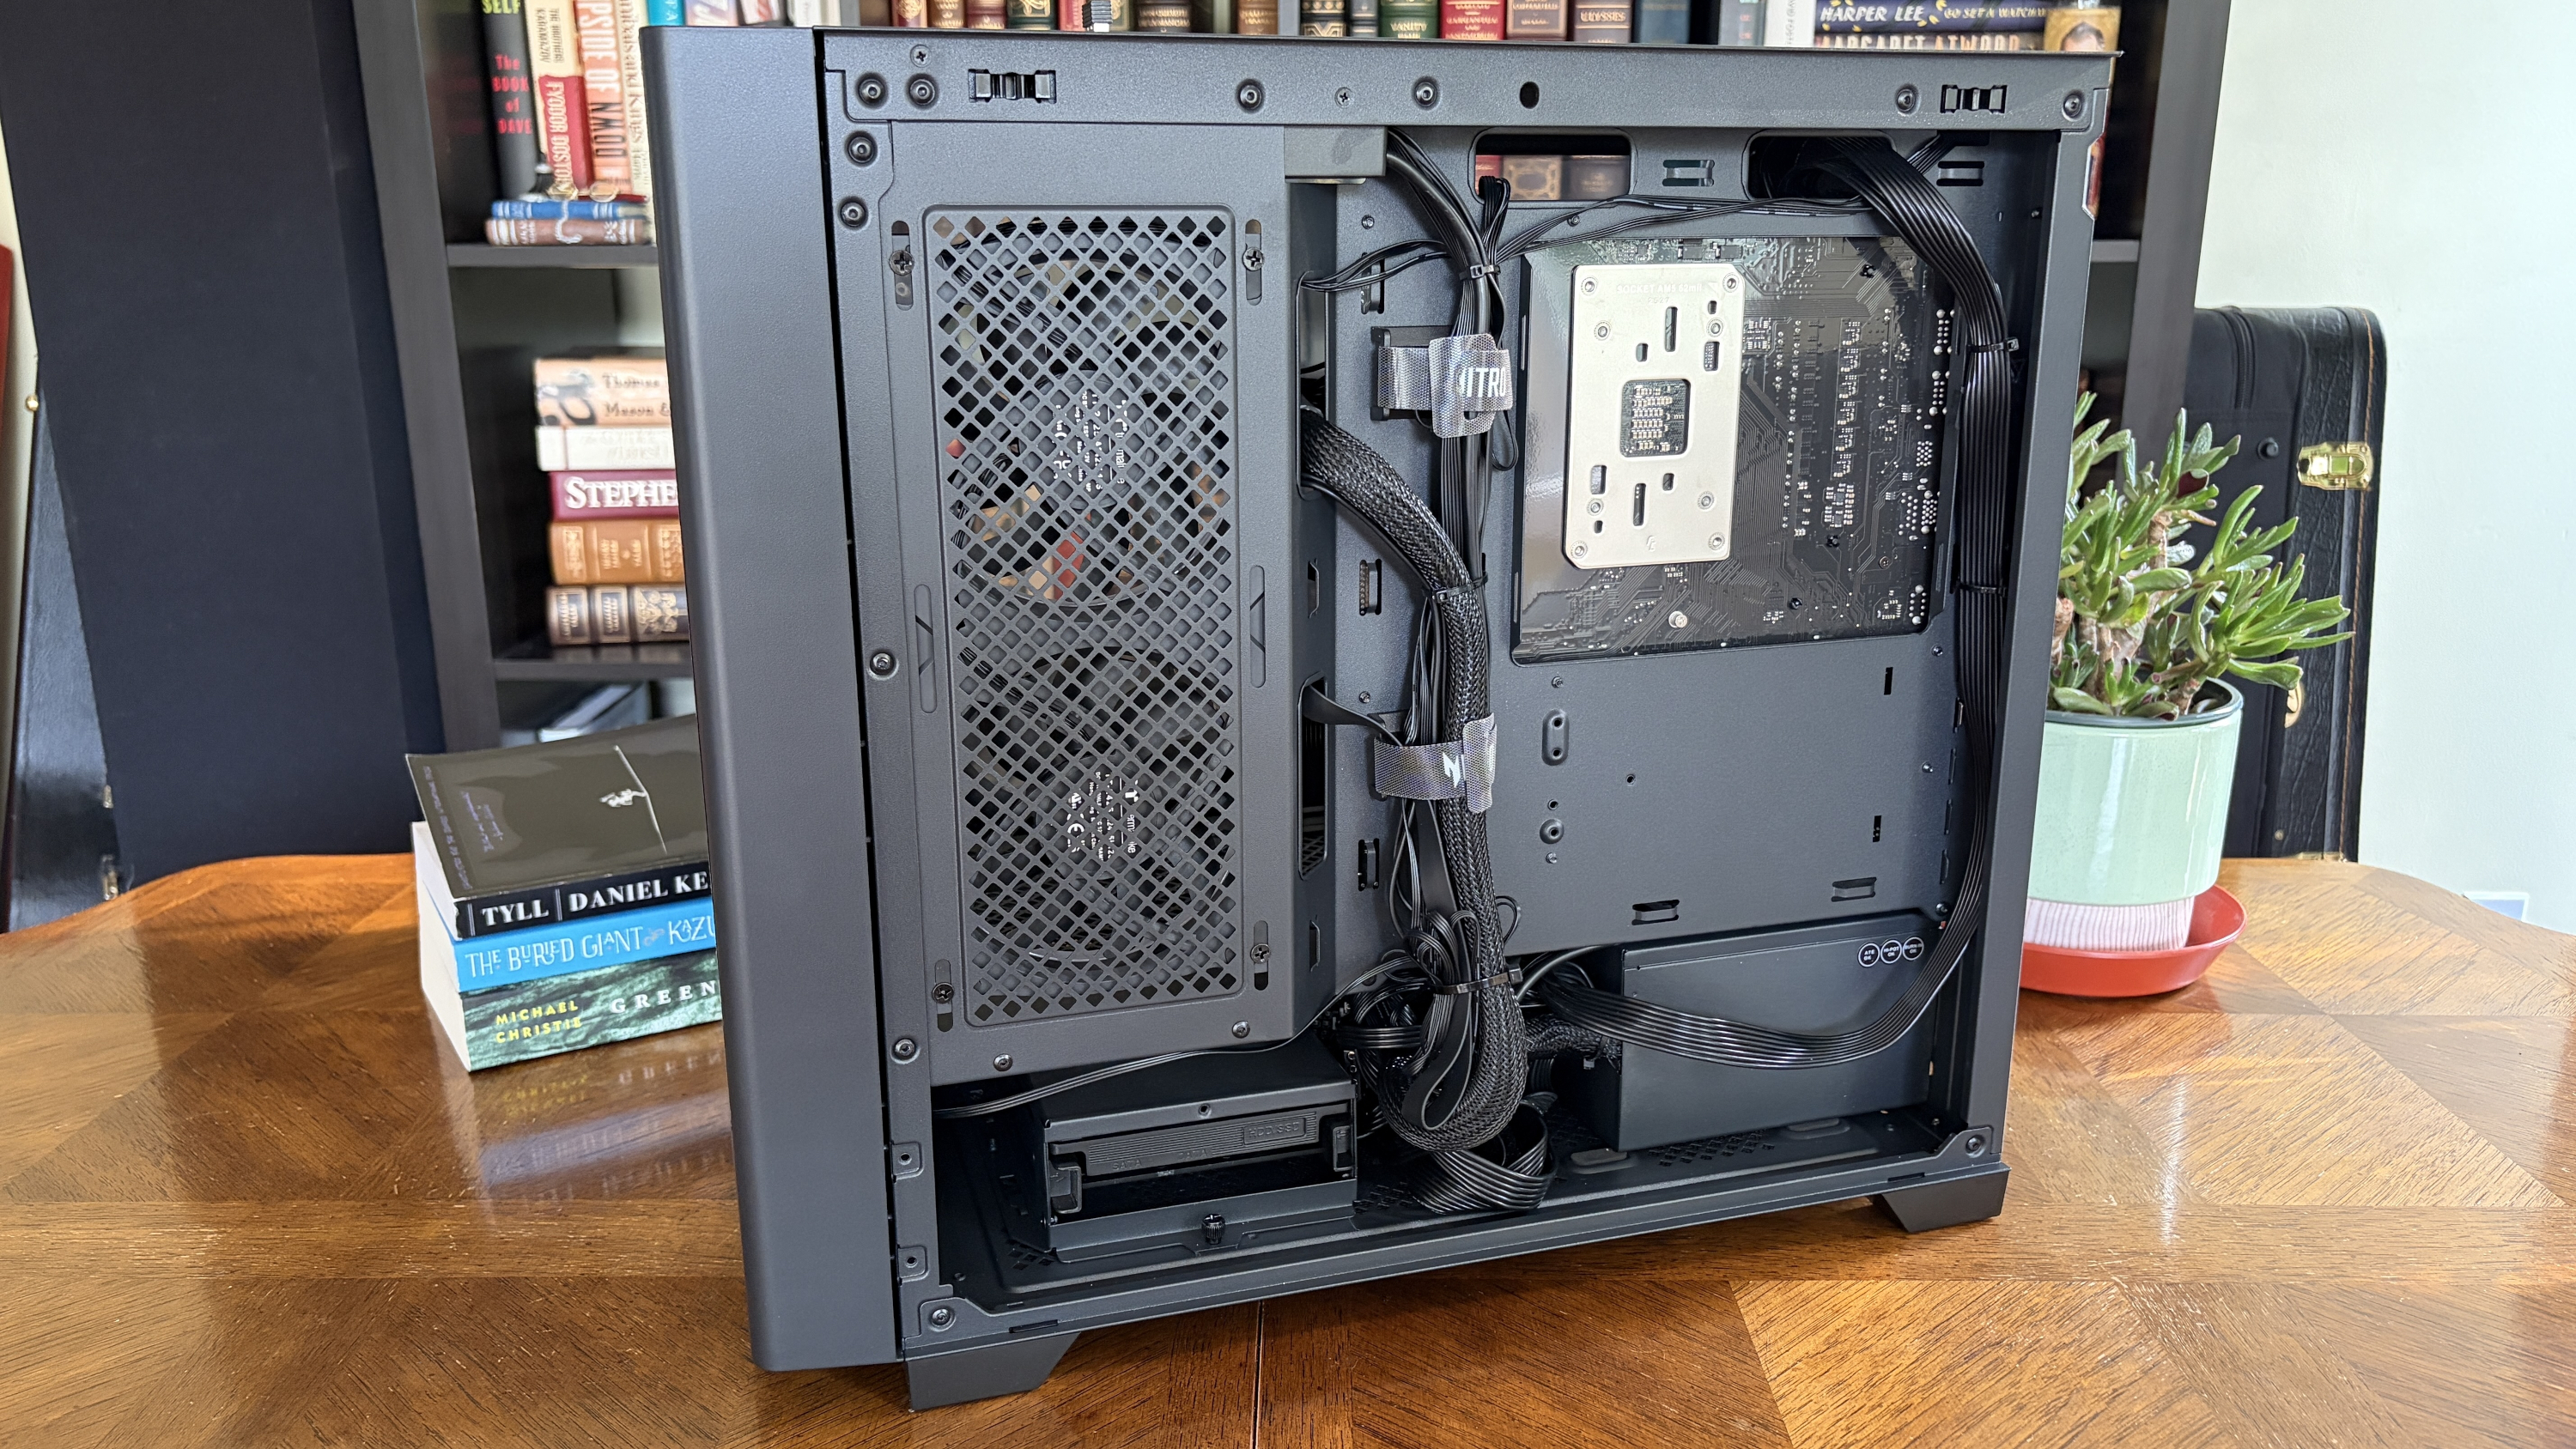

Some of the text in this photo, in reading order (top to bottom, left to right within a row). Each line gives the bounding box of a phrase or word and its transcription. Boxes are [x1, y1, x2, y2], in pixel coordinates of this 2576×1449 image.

[1580, 12, 1625, 22] ULYSSES
[1820, 5, 1924, 21] HARPER LEE
[1391, 21, 1427, 32] VANITY
[495, 54, 520, 70] The
[492, 76, 530, 93] BOOK
[586, 70, 621, 94] OF
[505, 97, 520, 112] of
[545, 81, 568, 133] FYODOR
[498, 118, 532, 135] DAVE
[1617, 284, 1655, 294] SOCKET
[1656, 283, 1676, 294] AM5
[602, 373, 660, 389] Thomas
[603, 402, 654, 417] Mason
[568, 879, 669, 912] DANIEL
[482, 899, 550, 927] TYLL
[465, 949, 502, 978] THE
[507, 937, 575, 972] BURIED
[581, 926, 644, 959] GIANT
[610, 980, 716, 1013] GREEN
[495, 1000, 579, 1026] MICHAEL
[495, 1016, 583, 1044] CHRISTIE
[1249, 1122, 1300, 1138] HDD/SSD
